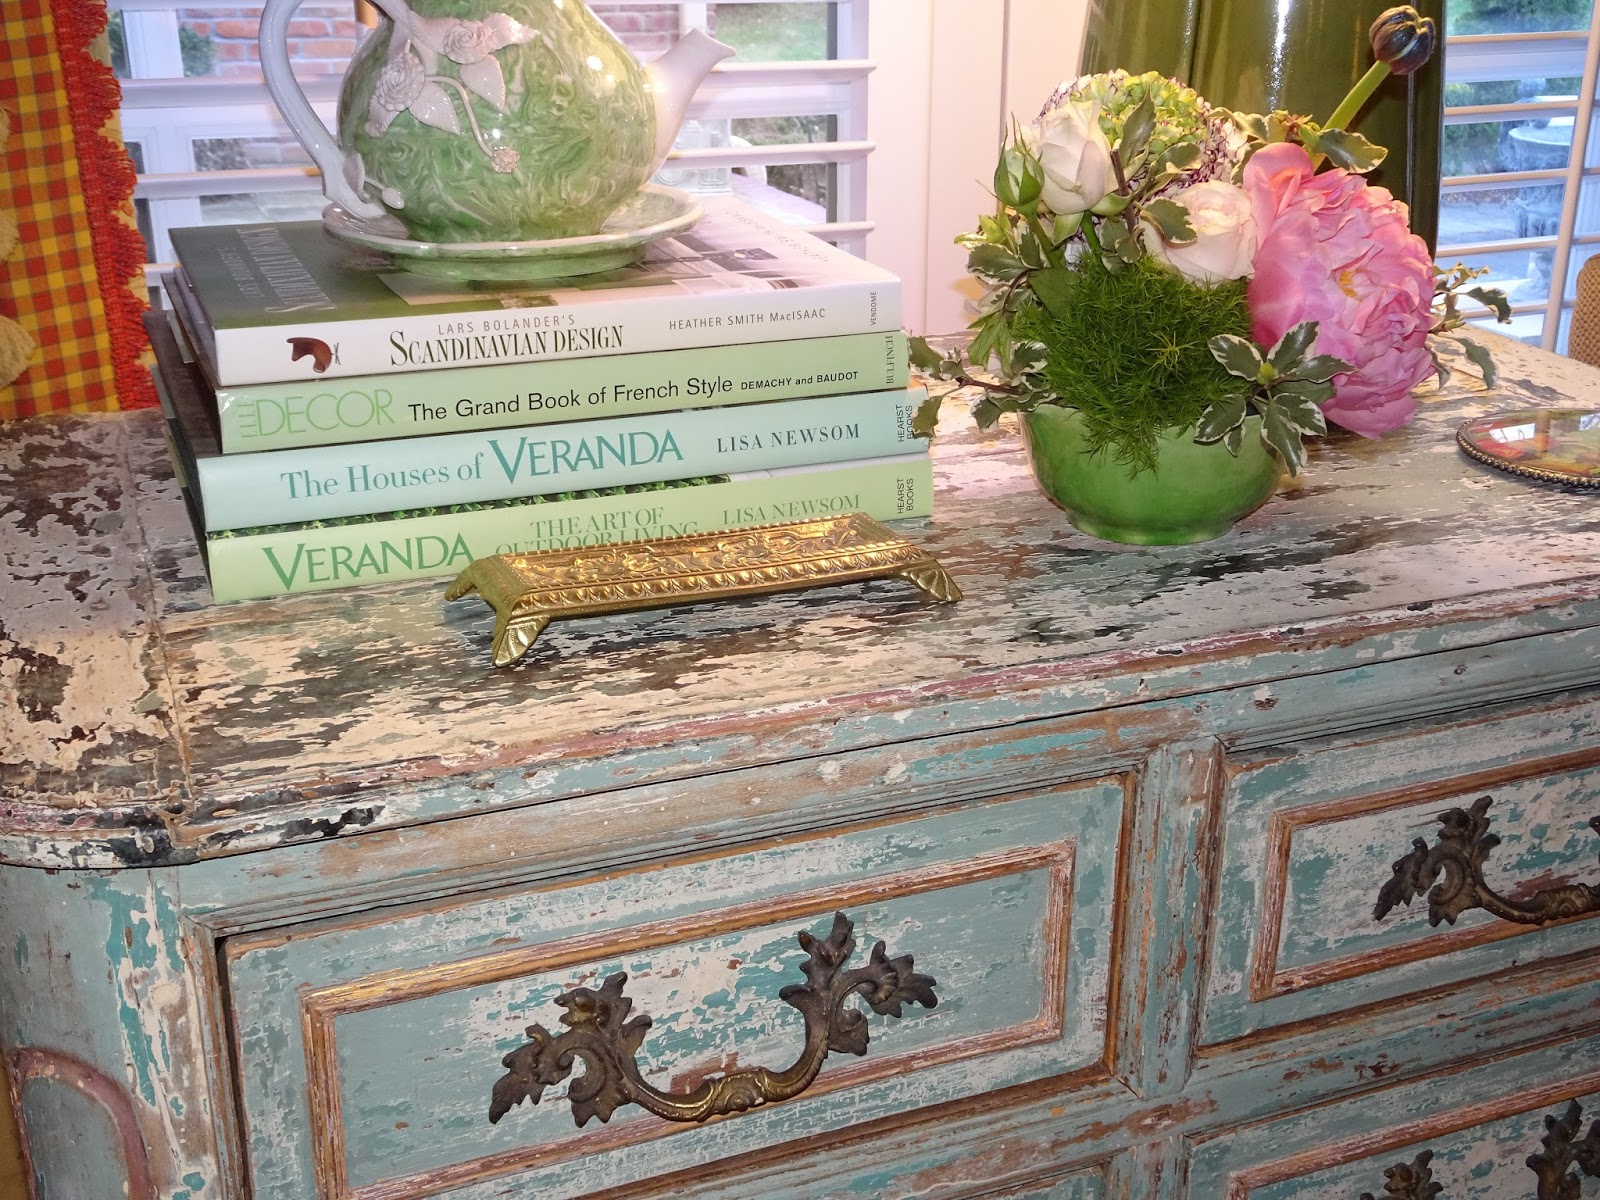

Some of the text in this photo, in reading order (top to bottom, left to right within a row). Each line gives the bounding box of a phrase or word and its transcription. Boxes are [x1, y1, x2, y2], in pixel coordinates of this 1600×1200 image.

[438, 314, 575, 335] LARS BOLANDER'S
[669, 316, 722, 330] HEATHER
[727, 313, 764, 326] SMITH
[389, 324, 624, 367] SCANDINAVIAN DESIGN
[885, 335, 894, 384] BULFINCH
[256, 388, 396, 437] DECOR
[408, 371, 859, 422] The Grand Book of French Style DEMACHY and BAUDOT
[717, 423, 860, 453] LISA NEWSOM
[895, 404, 904, 442] HEARST
[905, 405, 913, 439] BOOKS
[280, 428, 684, 500] The Houses of VERANDA
[722, 494, 860, 525] LISA NEWSOM
[896, 478, 904, 514] HEARST
[906, 478, 914, 511] BOOKS
[530, 506, 664, 539] THE ART OF
[261, 532, 475, 591] VERANDA
